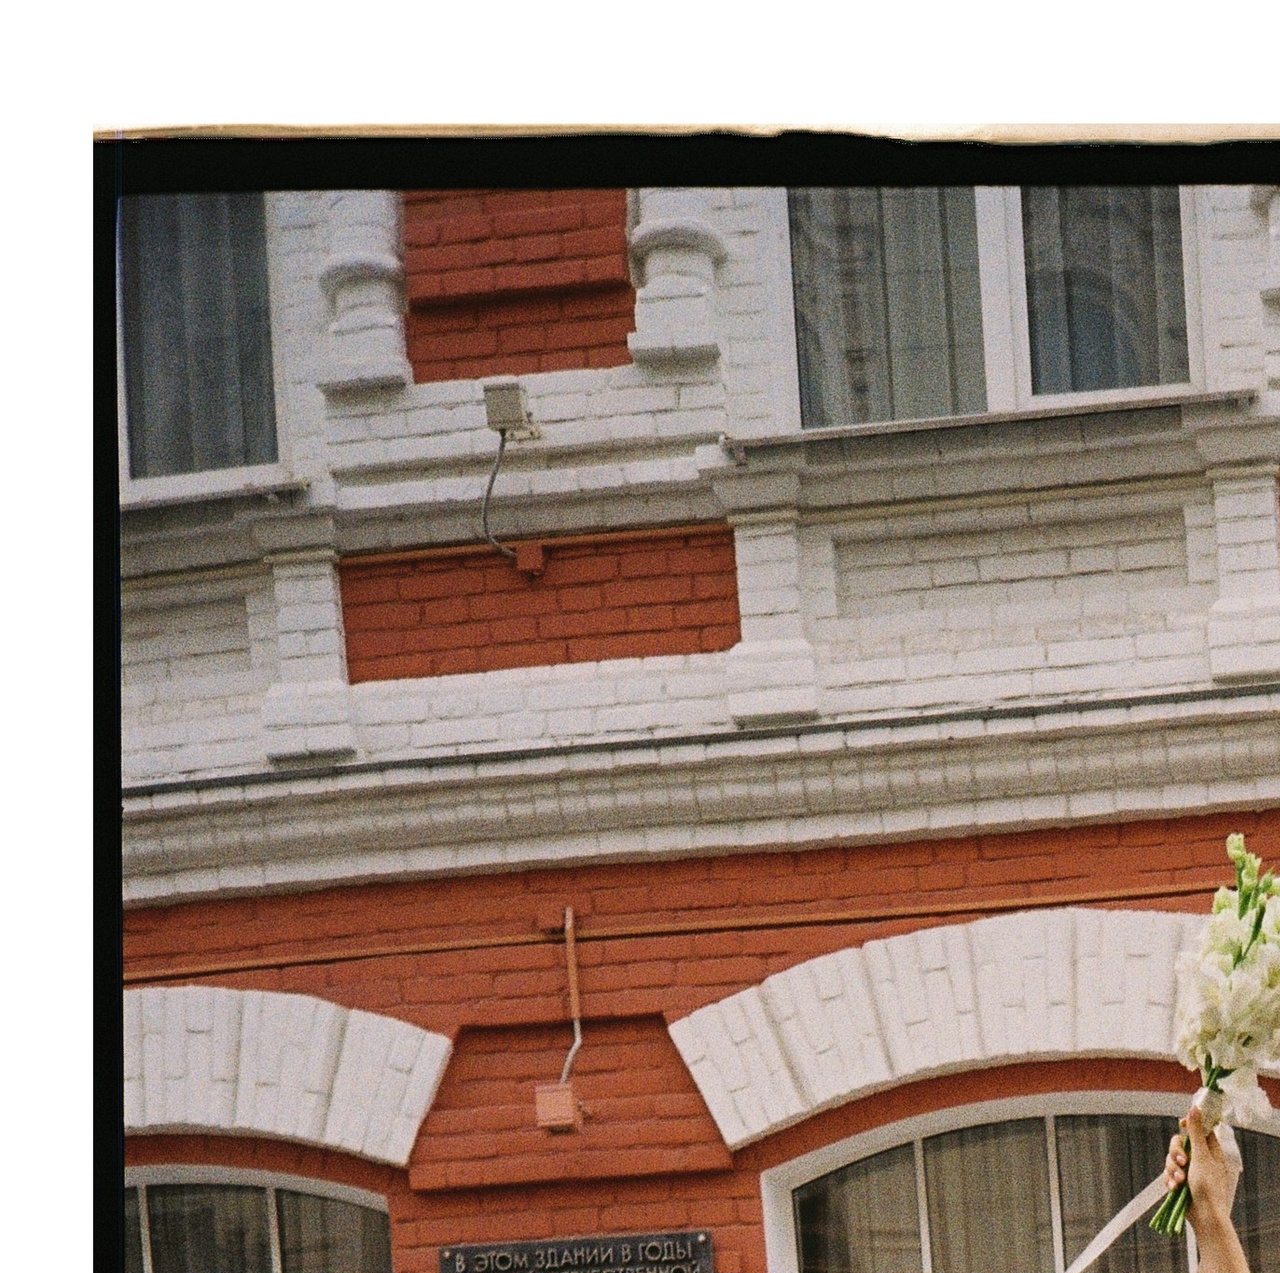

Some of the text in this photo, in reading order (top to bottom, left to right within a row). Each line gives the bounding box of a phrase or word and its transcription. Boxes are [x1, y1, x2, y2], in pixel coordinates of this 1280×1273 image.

[455, 1239, 693, 1273] В ЭТОМ ЗДАНИИ В ГОДЫ
